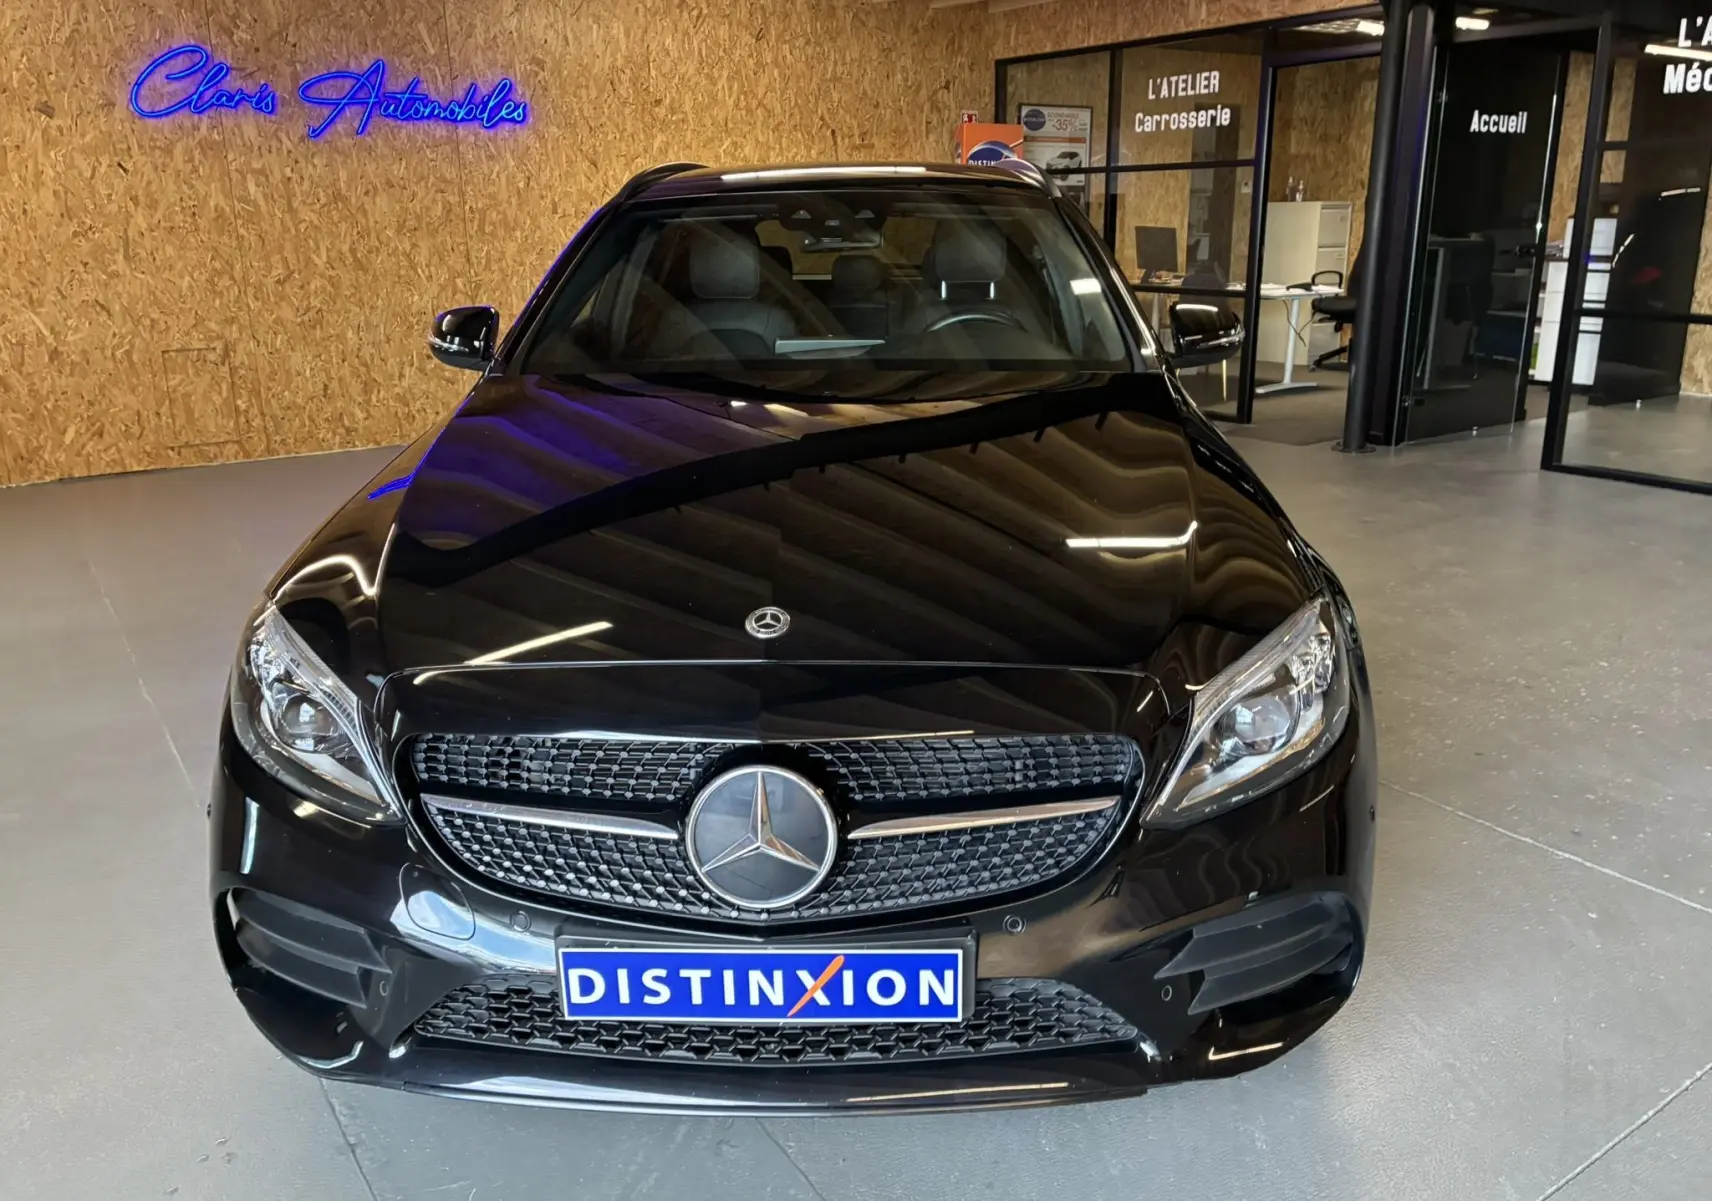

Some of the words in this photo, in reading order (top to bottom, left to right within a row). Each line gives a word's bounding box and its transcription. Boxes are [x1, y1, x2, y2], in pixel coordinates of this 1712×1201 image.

[130, 44, 276, 118] Claris
[297, 59, 528, 138] Automobiles
[1147, 70, 1220, 100] L'ATELIER
[1134, 104, 1231, 133] Carrosserie
[1469, 109, 1528, 134] Accueil
[567, 955, 955, 1016] DISTINXION
